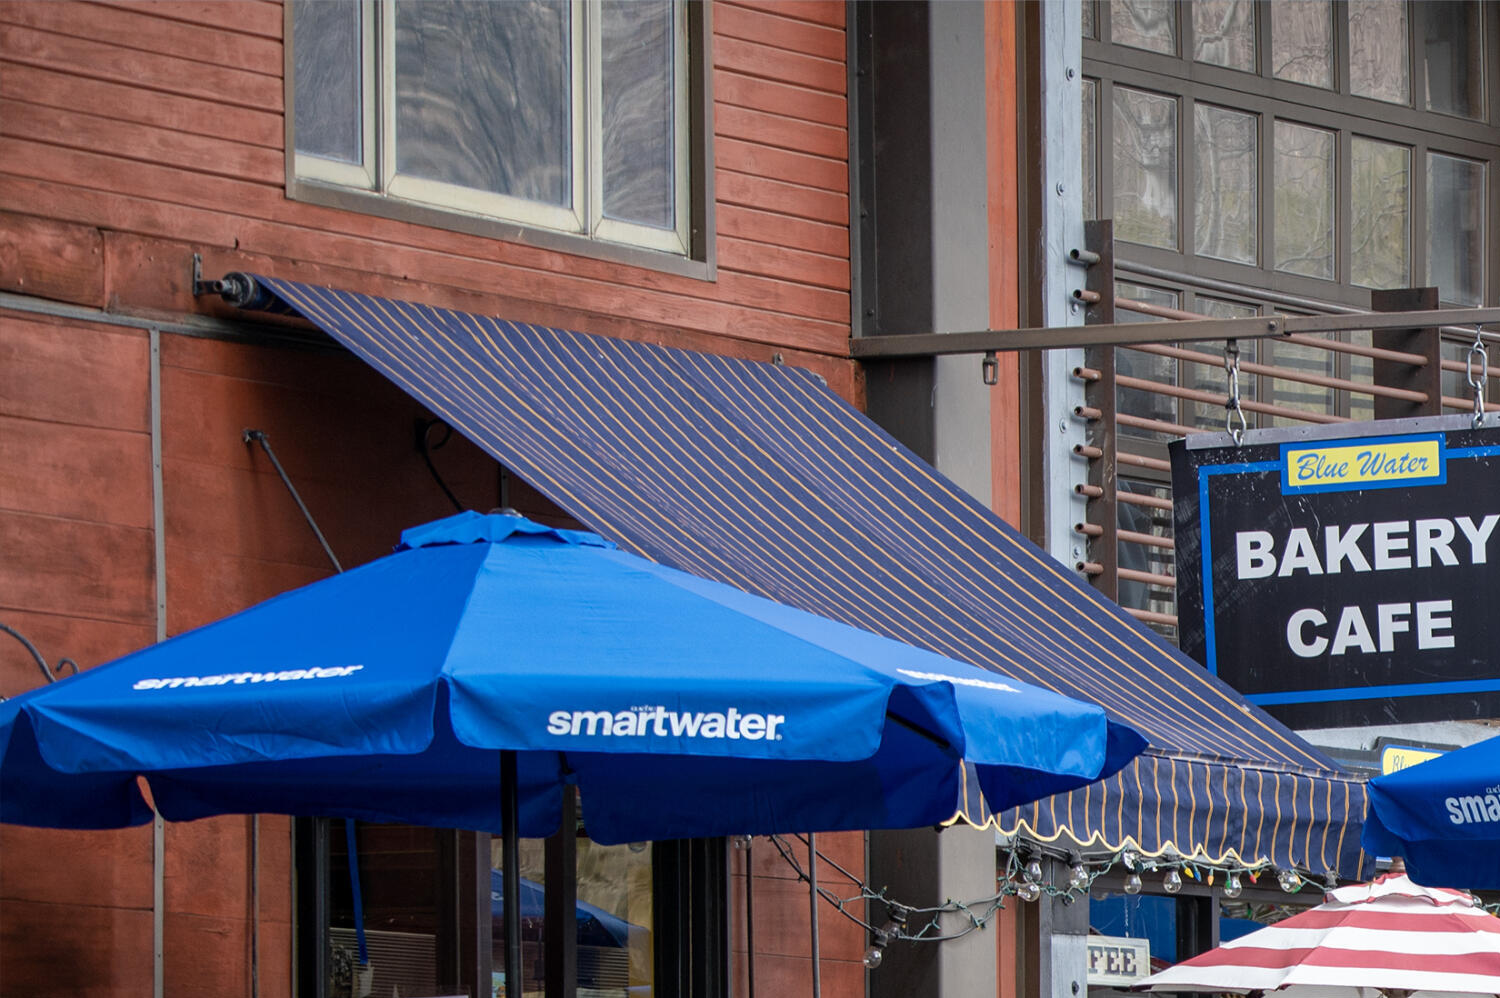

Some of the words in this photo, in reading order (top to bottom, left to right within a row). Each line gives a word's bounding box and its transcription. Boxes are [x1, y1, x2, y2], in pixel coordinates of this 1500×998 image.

[1296, 452, 1349, 481] Blue
[1356, 450, 1430, 477] Water
[1235, 514, 1500, 580] BAKERY
[1286, 600, 1455, 658] CAFE
[133, 665, 364, 690] smartwater
[547, 705, 786, 741] smartwater
